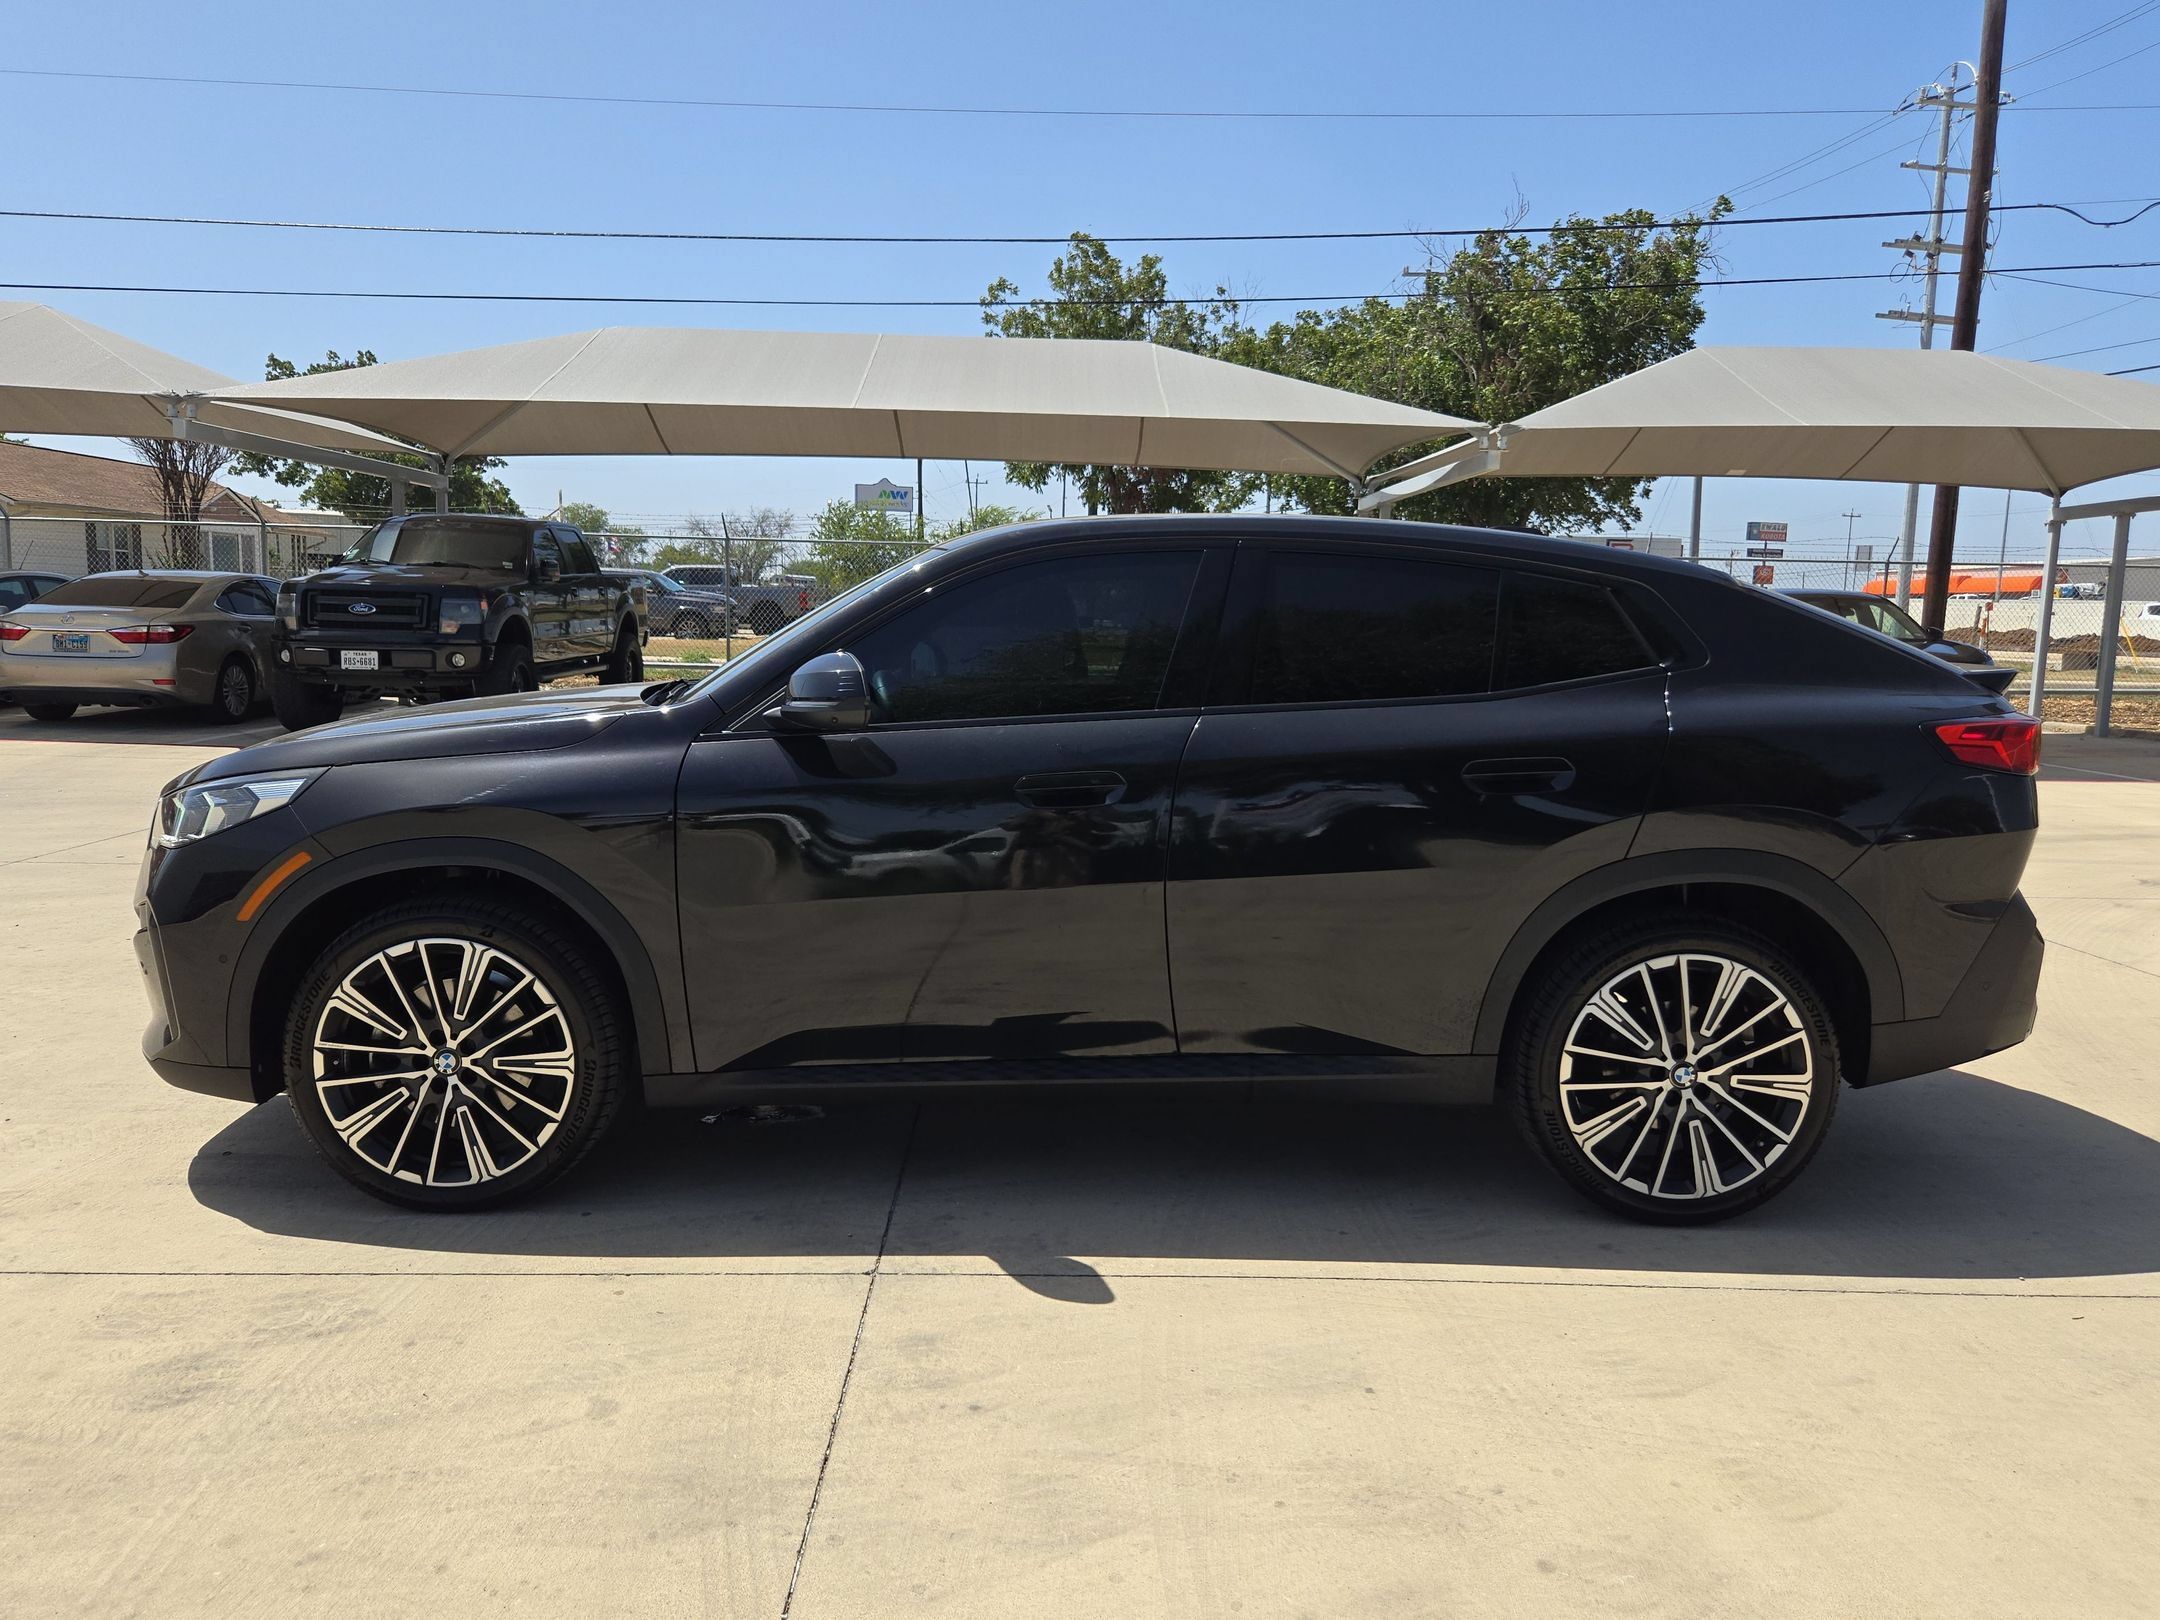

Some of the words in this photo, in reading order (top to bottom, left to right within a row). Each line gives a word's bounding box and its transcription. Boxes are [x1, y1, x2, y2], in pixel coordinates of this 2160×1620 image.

[289, 968, 331, 1070] BRIDGESTONE
[1768, 960, 1831, 1046] BRIDGESTONE
[555, 1058, 597, 1156] BRIDGESTONE
